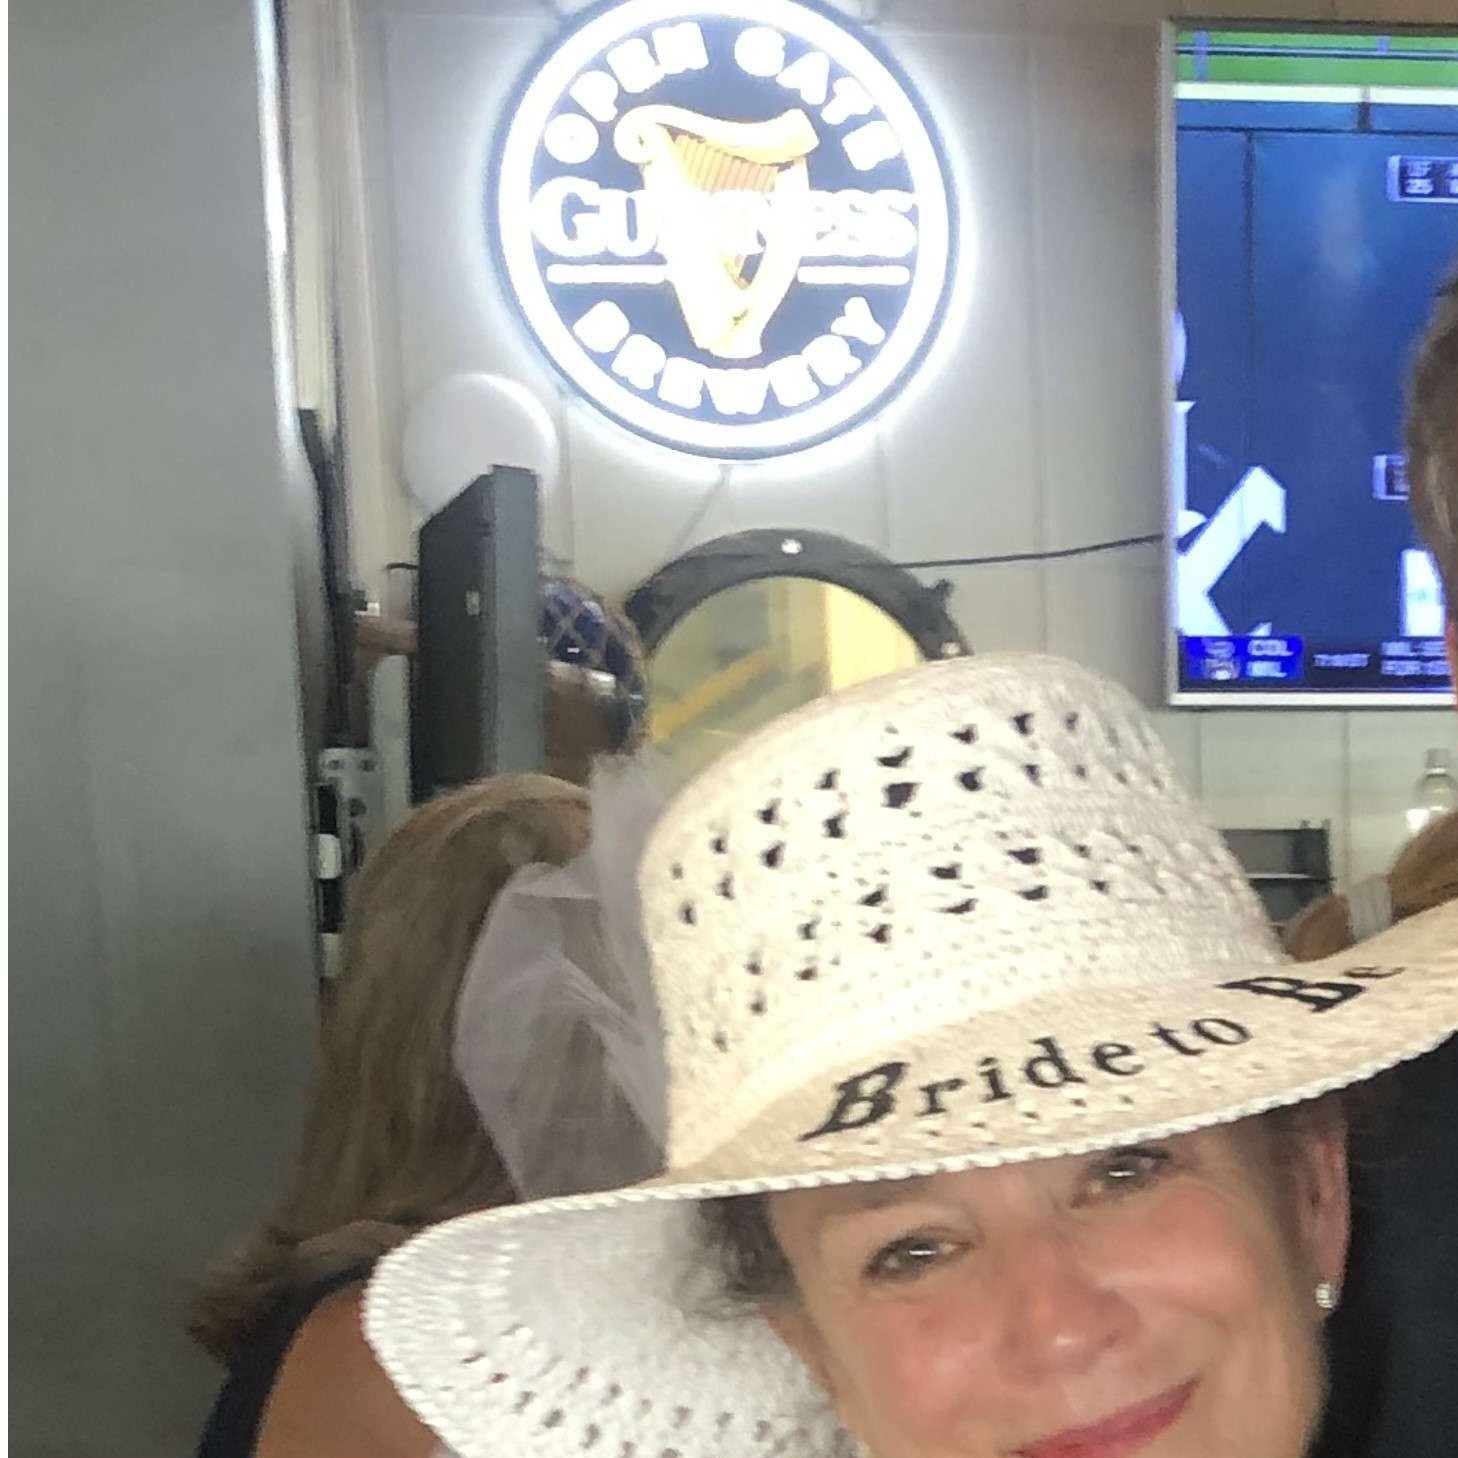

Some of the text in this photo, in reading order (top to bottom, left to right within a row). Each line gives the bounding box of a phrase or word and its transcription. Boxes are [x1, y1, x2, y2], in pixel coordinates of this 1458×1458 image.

[796, 964, 1405, 1141] Bride to Be
